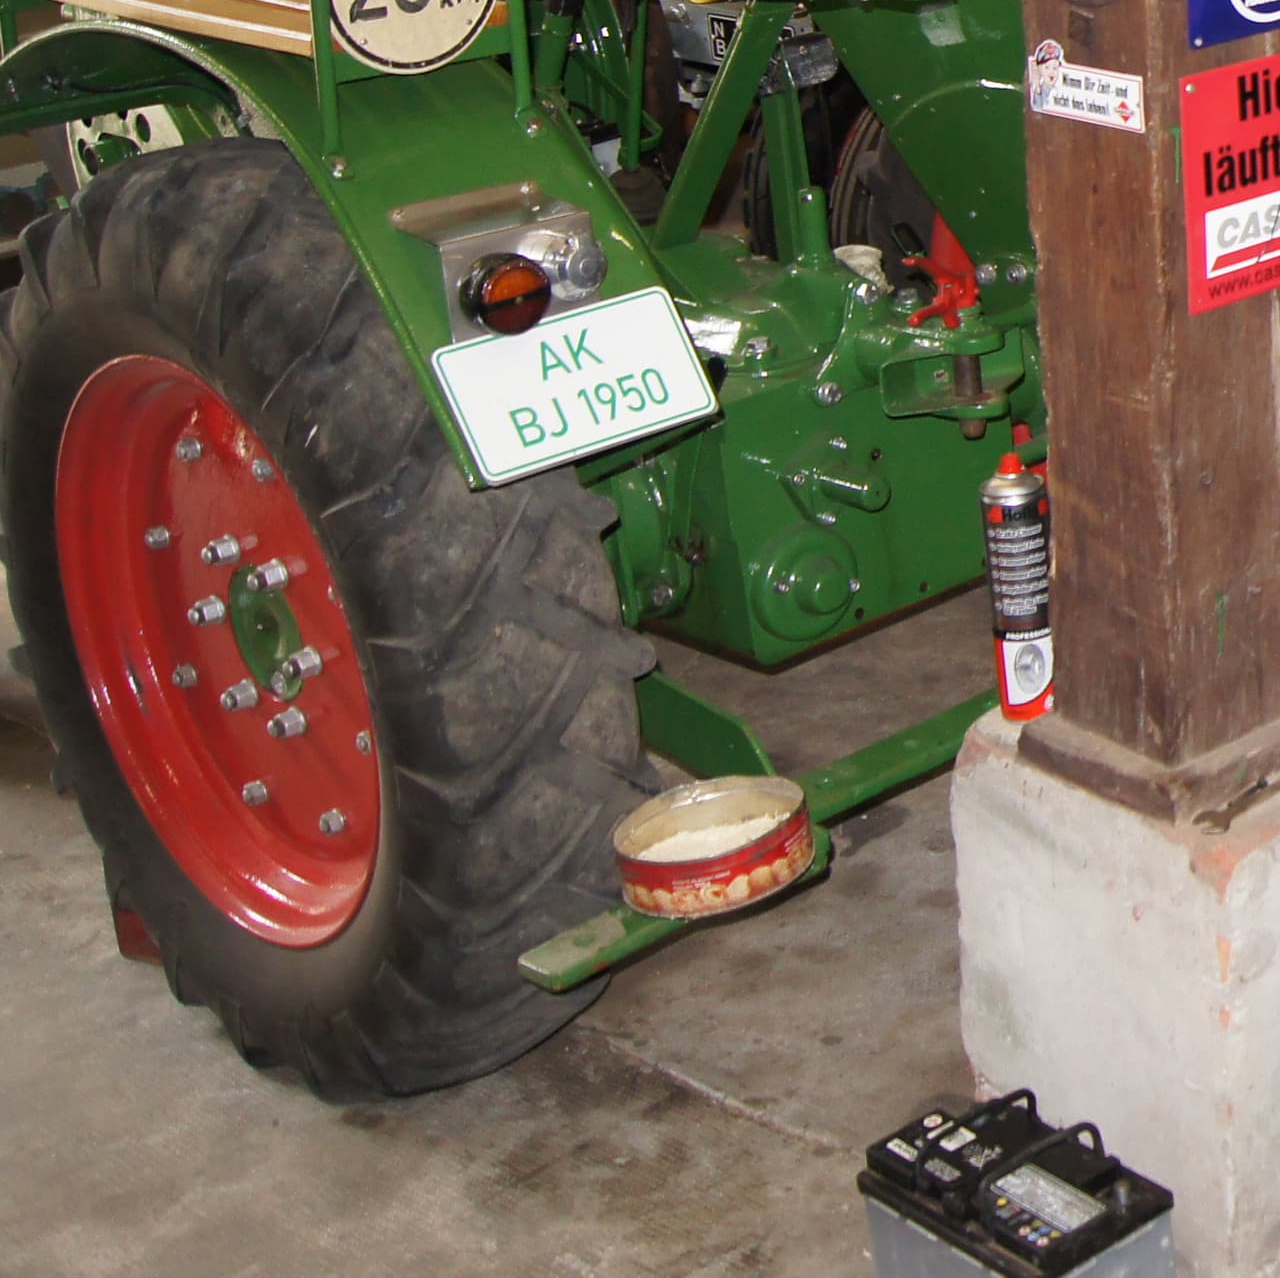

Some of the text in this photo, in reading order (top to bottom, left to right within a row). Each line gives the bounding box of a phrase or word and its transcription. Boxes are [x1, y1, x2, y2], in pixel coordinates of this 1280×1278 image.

[1053, 93, 1069, 107] nicht
[1084, 76, 1095, 91] Dir
[1097, 79, 1111, 94] Zeit
[1115, 85, 1128, 98] und
[539, 327, 604, 381] AK
[509, 368, 670, 449] BJ 1950
